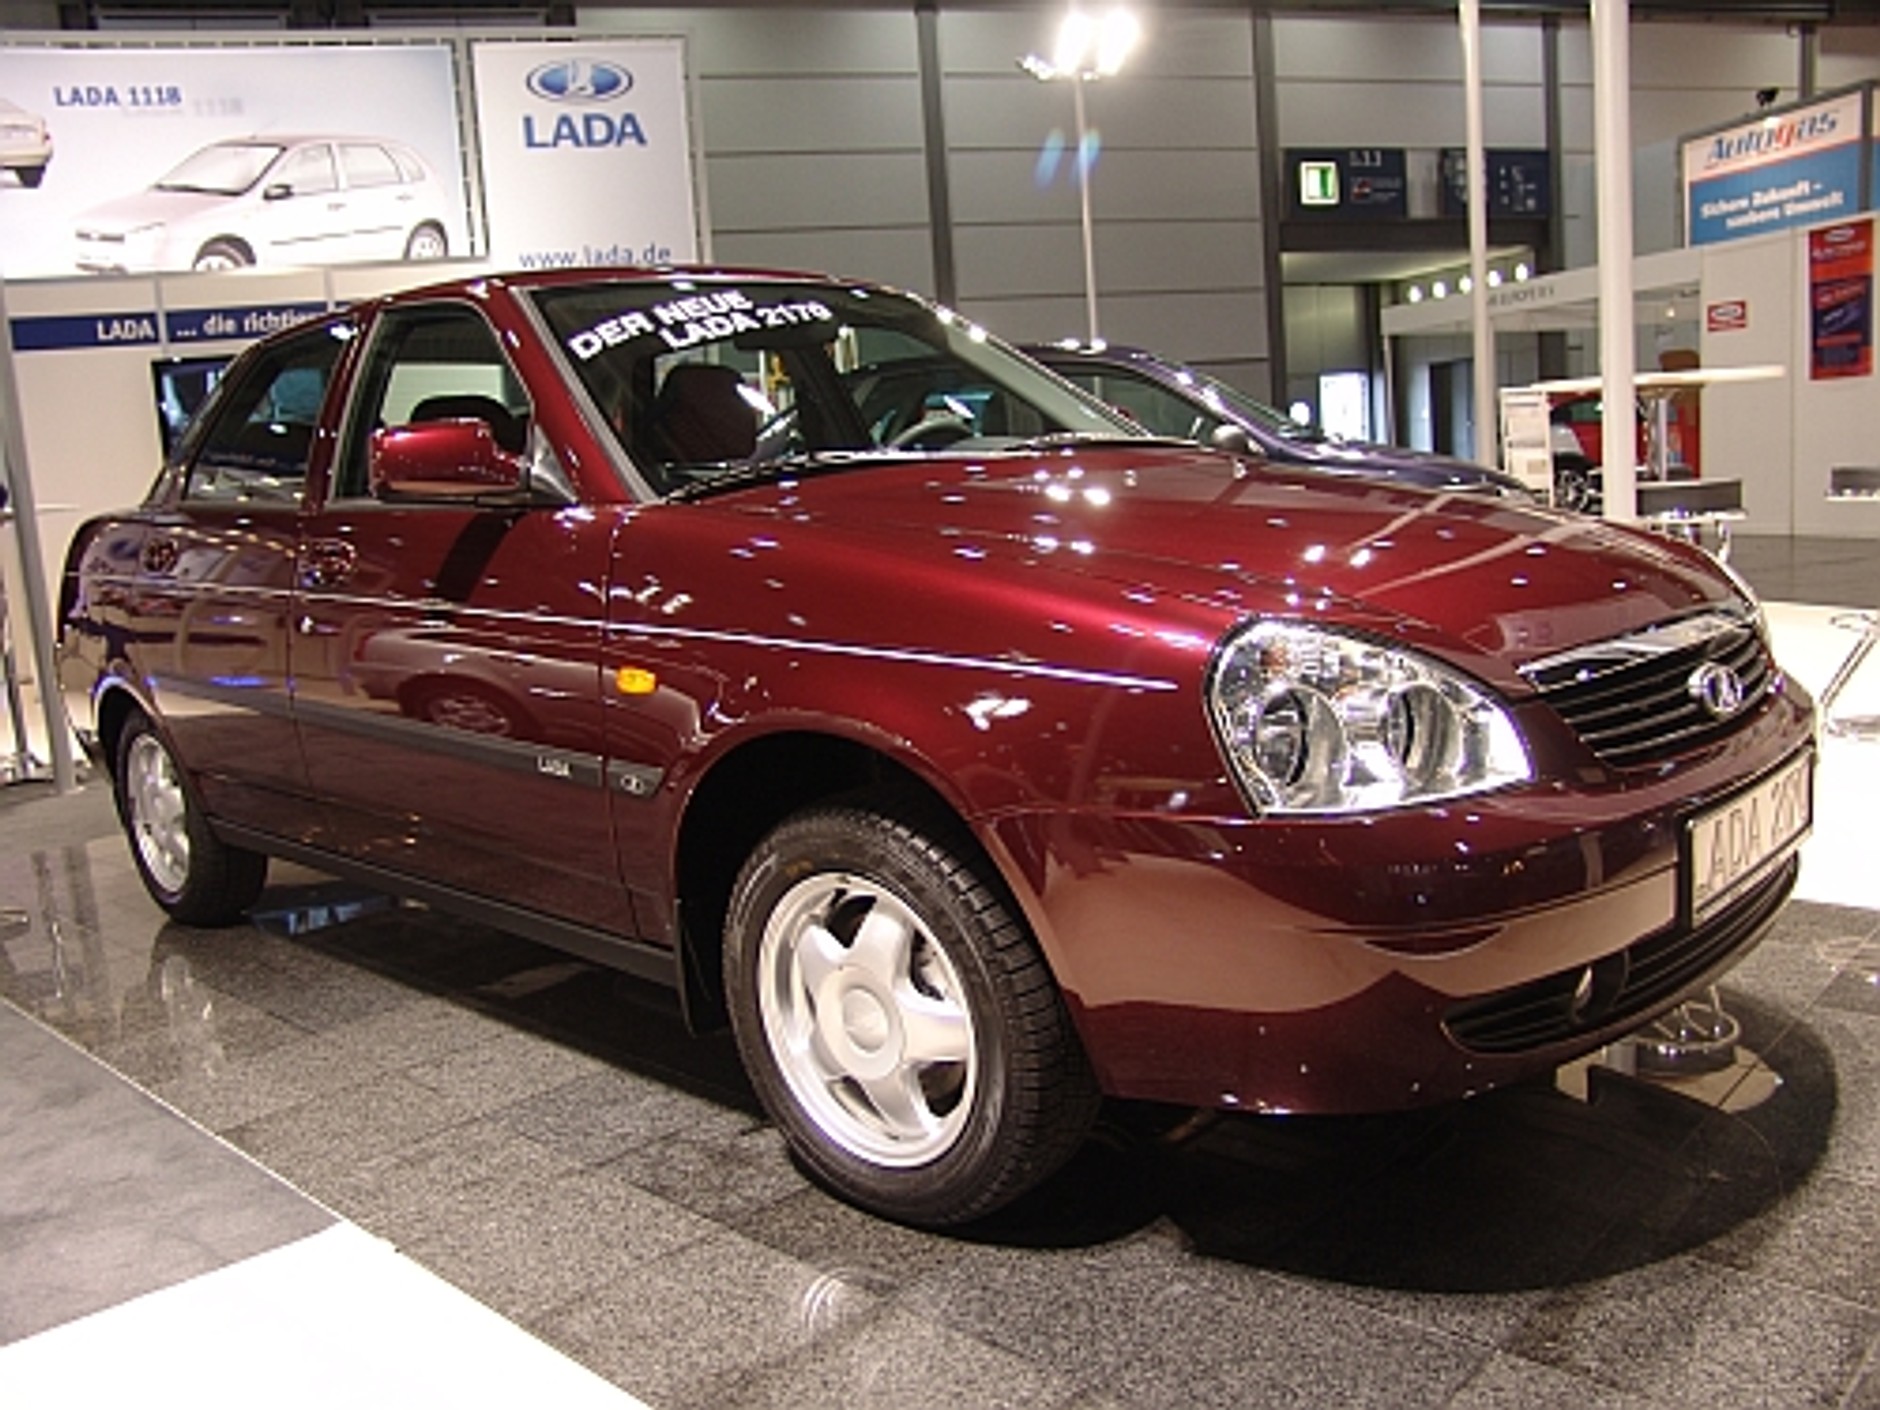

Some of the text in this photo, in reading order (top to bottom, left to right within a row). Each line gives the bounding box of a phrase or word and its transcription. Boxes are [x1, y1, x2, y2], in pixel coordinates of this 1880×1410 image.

[53, 86, 182, 106] LADA 1118
[523, 112, 647, 148] LADA
[519, 243, 671, 268] www.lada.de
[97, 319, 155, 341] LADA
[203, 312, 236, 336] die
[568, 289, 753, 361] DER NEUE
[658, 311, 762, 350] LADA
